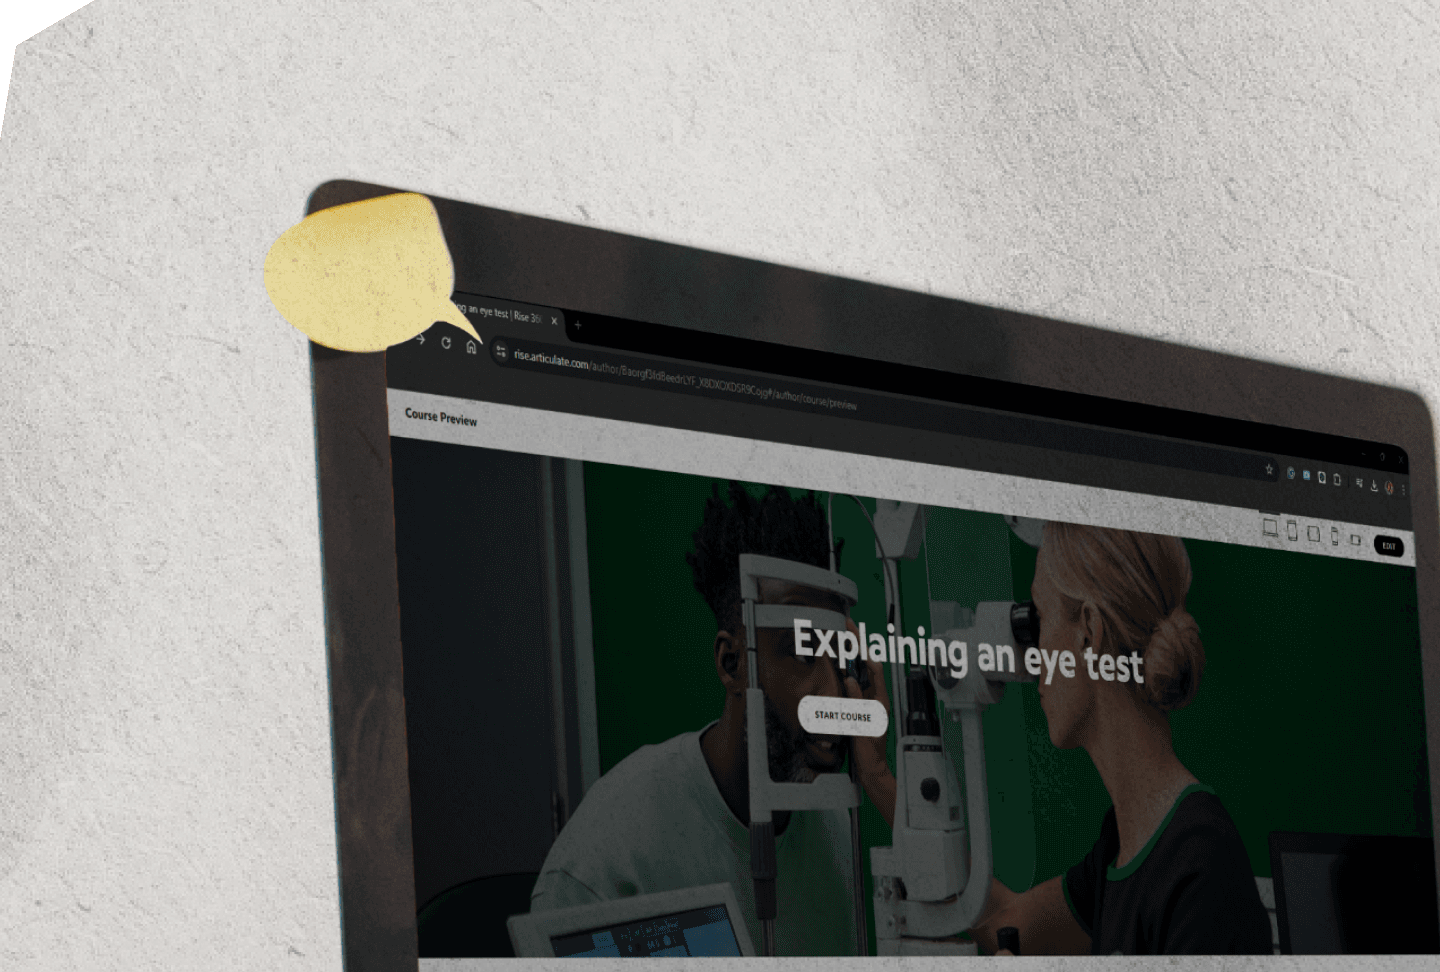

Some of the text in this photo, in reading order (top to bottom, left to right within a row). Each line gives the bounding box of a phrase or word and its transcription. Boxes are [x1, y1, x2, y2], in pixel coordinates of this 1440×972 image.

[468, 305, 478, 314] an
[479, 307, 493, 318] eye
[494, 308, 509, 319] test
[514, 310, 529, 322] Rise
[405, 407, 478, 427] Course Preview
[1382, 541, 1396, 551] EDIT
[793, 618, 1145, 686] Explaining an eye test
[814, 710, 872, 723] START COURSE
